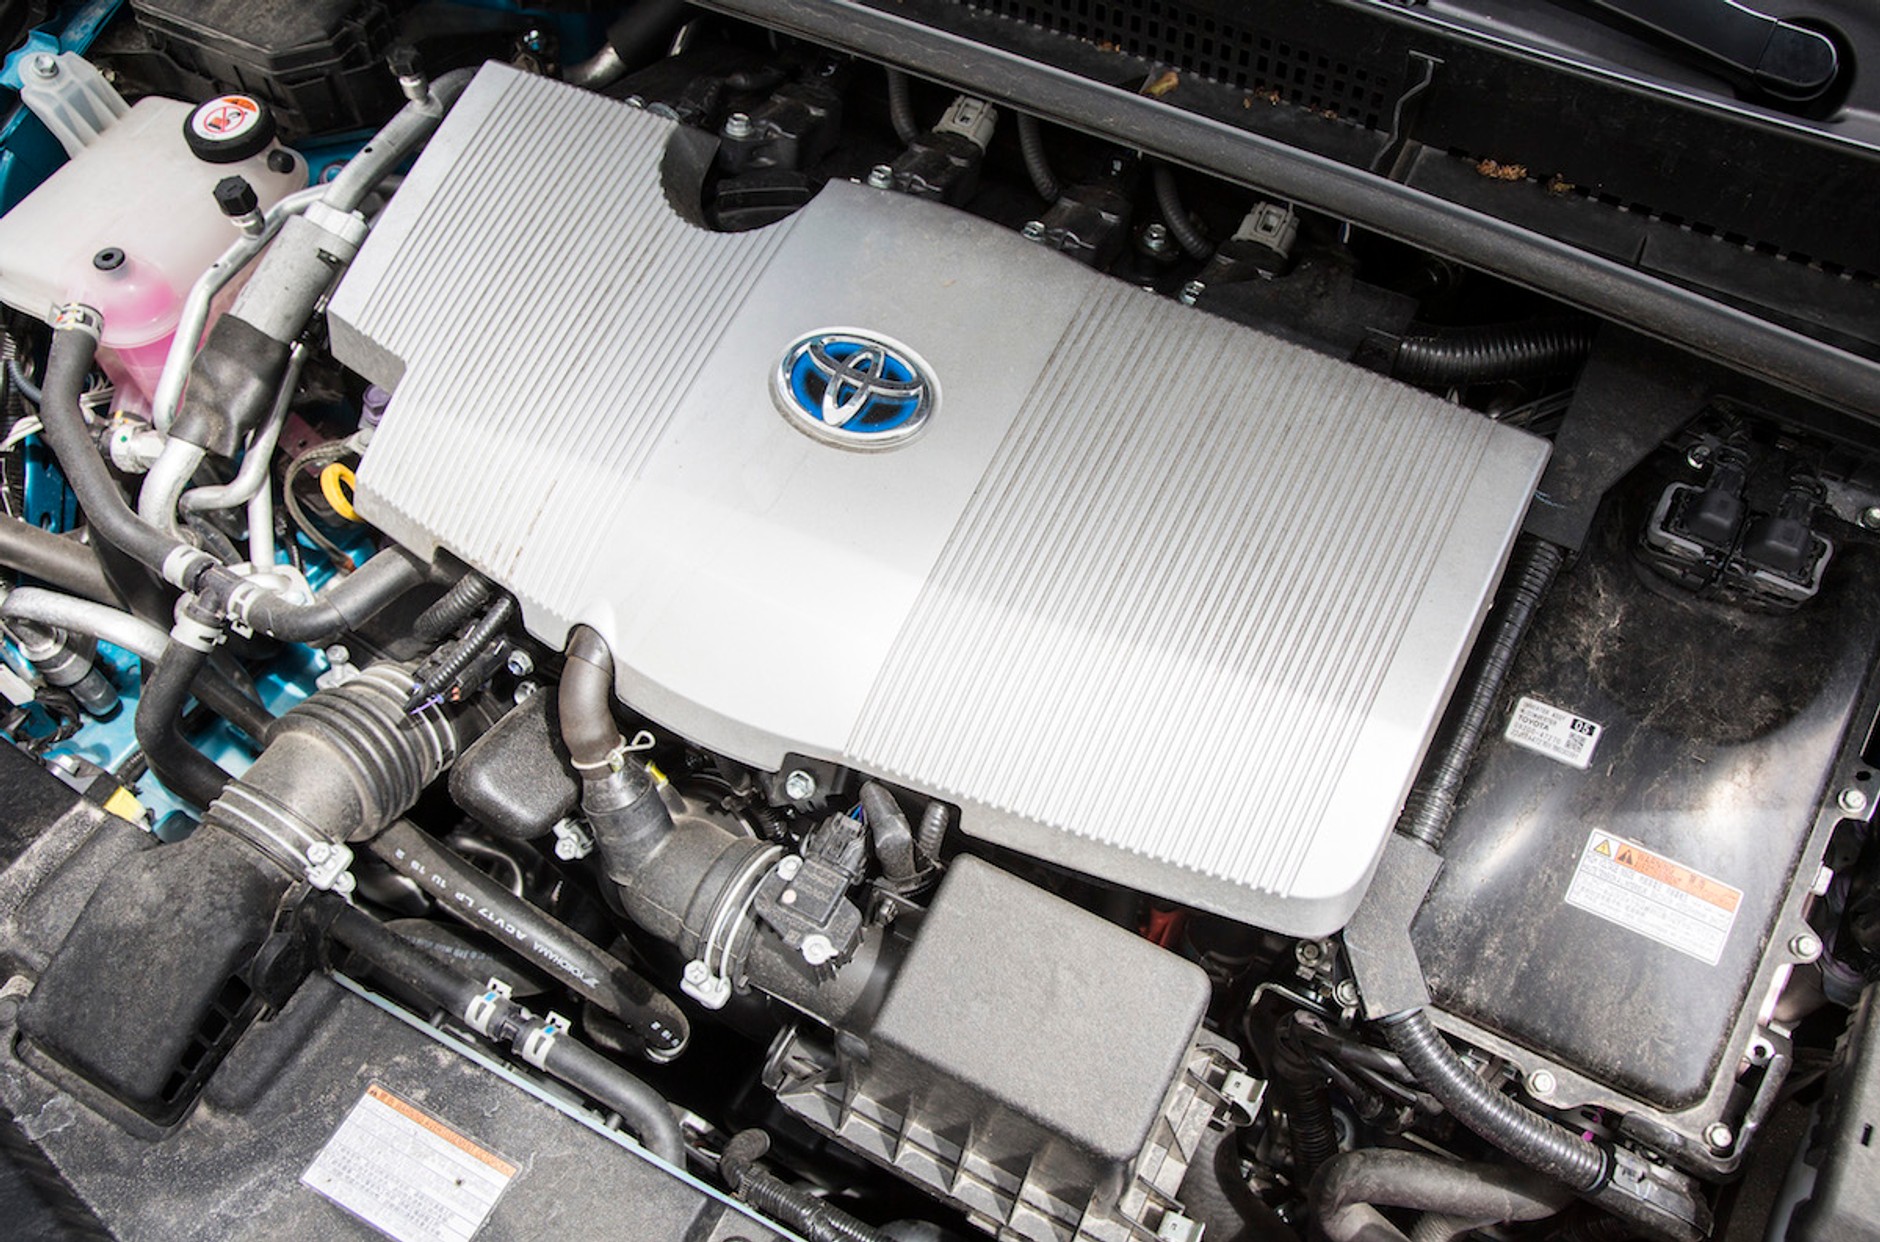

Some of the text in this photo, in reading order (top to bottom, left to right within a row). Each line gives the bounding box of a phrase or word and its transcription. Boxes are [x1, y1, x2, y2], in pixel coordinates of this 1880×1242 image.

[1517, 714, 1549, 730] TOYOTA
[455, 891, 475, 908] LP
[478, 908, 528, 941] ACV17
[532, 941, 586, 982] YOKOHAMA
